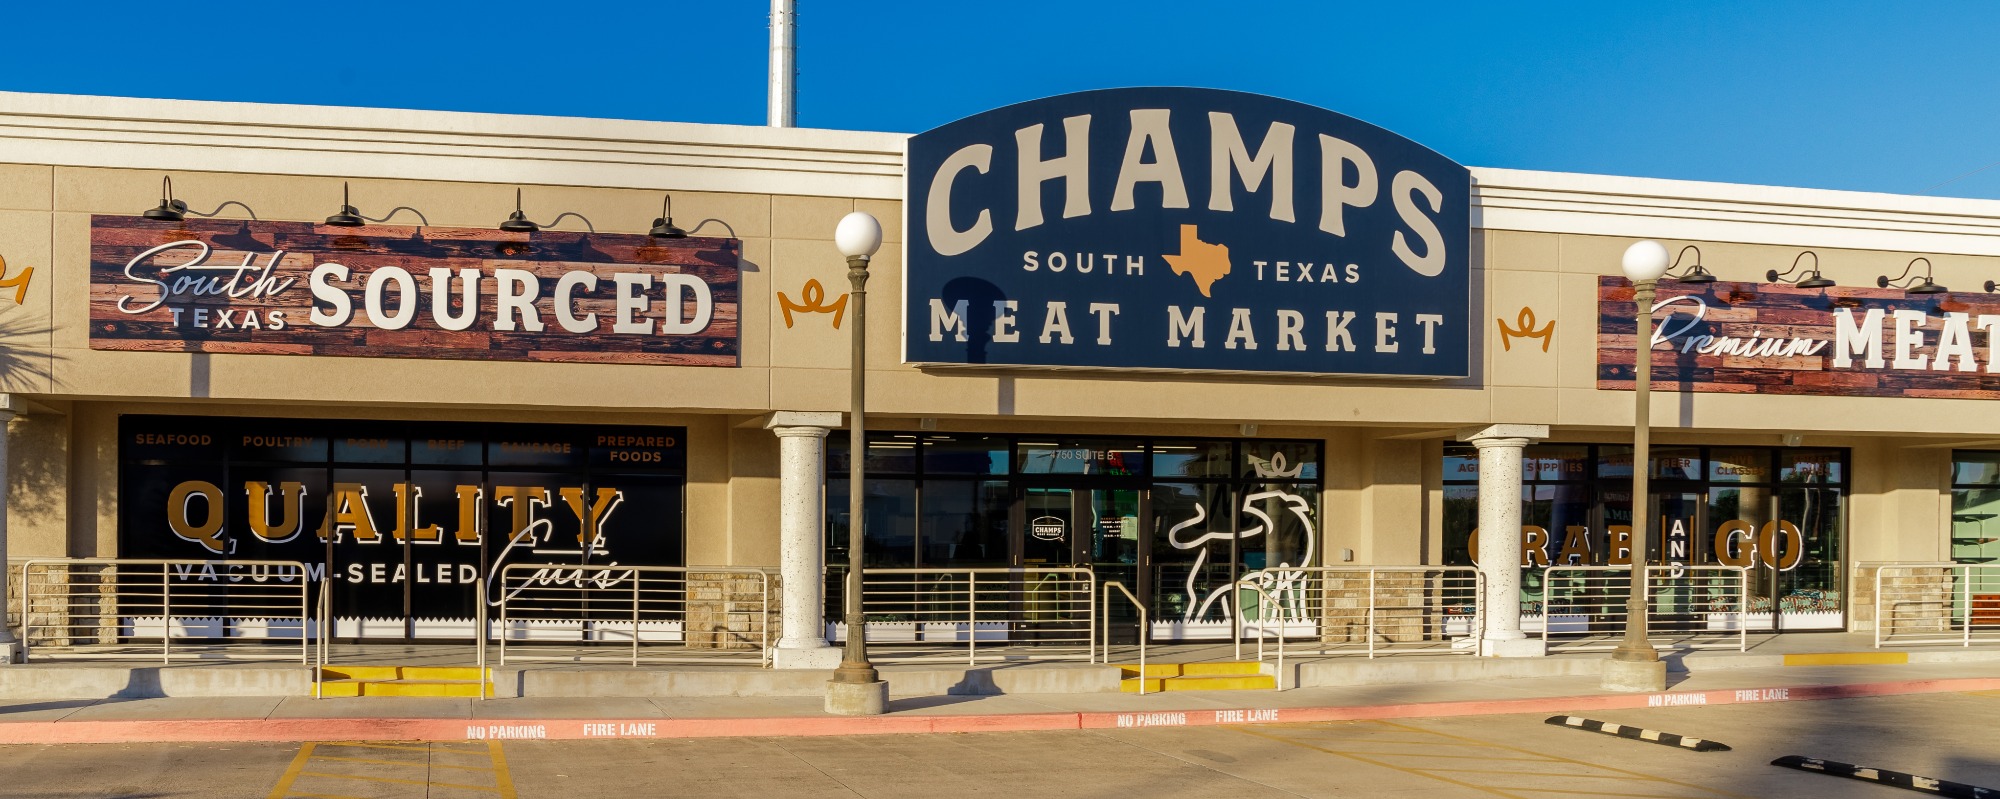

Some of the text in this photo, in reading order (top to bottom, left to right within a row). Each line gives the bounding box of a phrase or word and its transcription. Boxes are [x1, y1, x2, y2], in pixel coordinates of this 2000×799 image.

[926, 108, 1446, 277] CHAMPS
[1023, 251, 1360, 283] SOUTH TEXAS
[117, 240, 295, 314] South
[309, 263, 713, 335] SOURCED
[170, 307, 286, 331] TEXAS
[929, 298, 1444, 355] MEAT MARKET
[136, 434, 211, 446] SEAFOOD
[243, 436, 313, 447] POULTRY
[428, 439, 464, 451] BEEF
[598, 436, 675, 447] PREPARED
[610, 451, 662, 463] FOODS
[1050, 450, 1072, 459] 4750
[1075, 450, 1104, 460] SUITE
[1526, 463, 1583, 473] SUPPLIES
[1664, 458, 1690, 468] BEER
[1716, 466, 1765, 476] CLASSES
[167, 480, 624, 554] QUALITY
[1468, 519, 1803, 571] RAB GO
[1670, 519, 1685, 579] AND
[1648, 693, 1707, 707] NO PARKING
[1736, 688, 1789, 702] FIRE LANE
[1117, 712, 1186, 728] NO PARKING
[1215, 708, 1279, 723] FIRE LANE
[467, 724, 545, 739] NO PARKING
[583, 722, 656, 736] FIRE LANE
